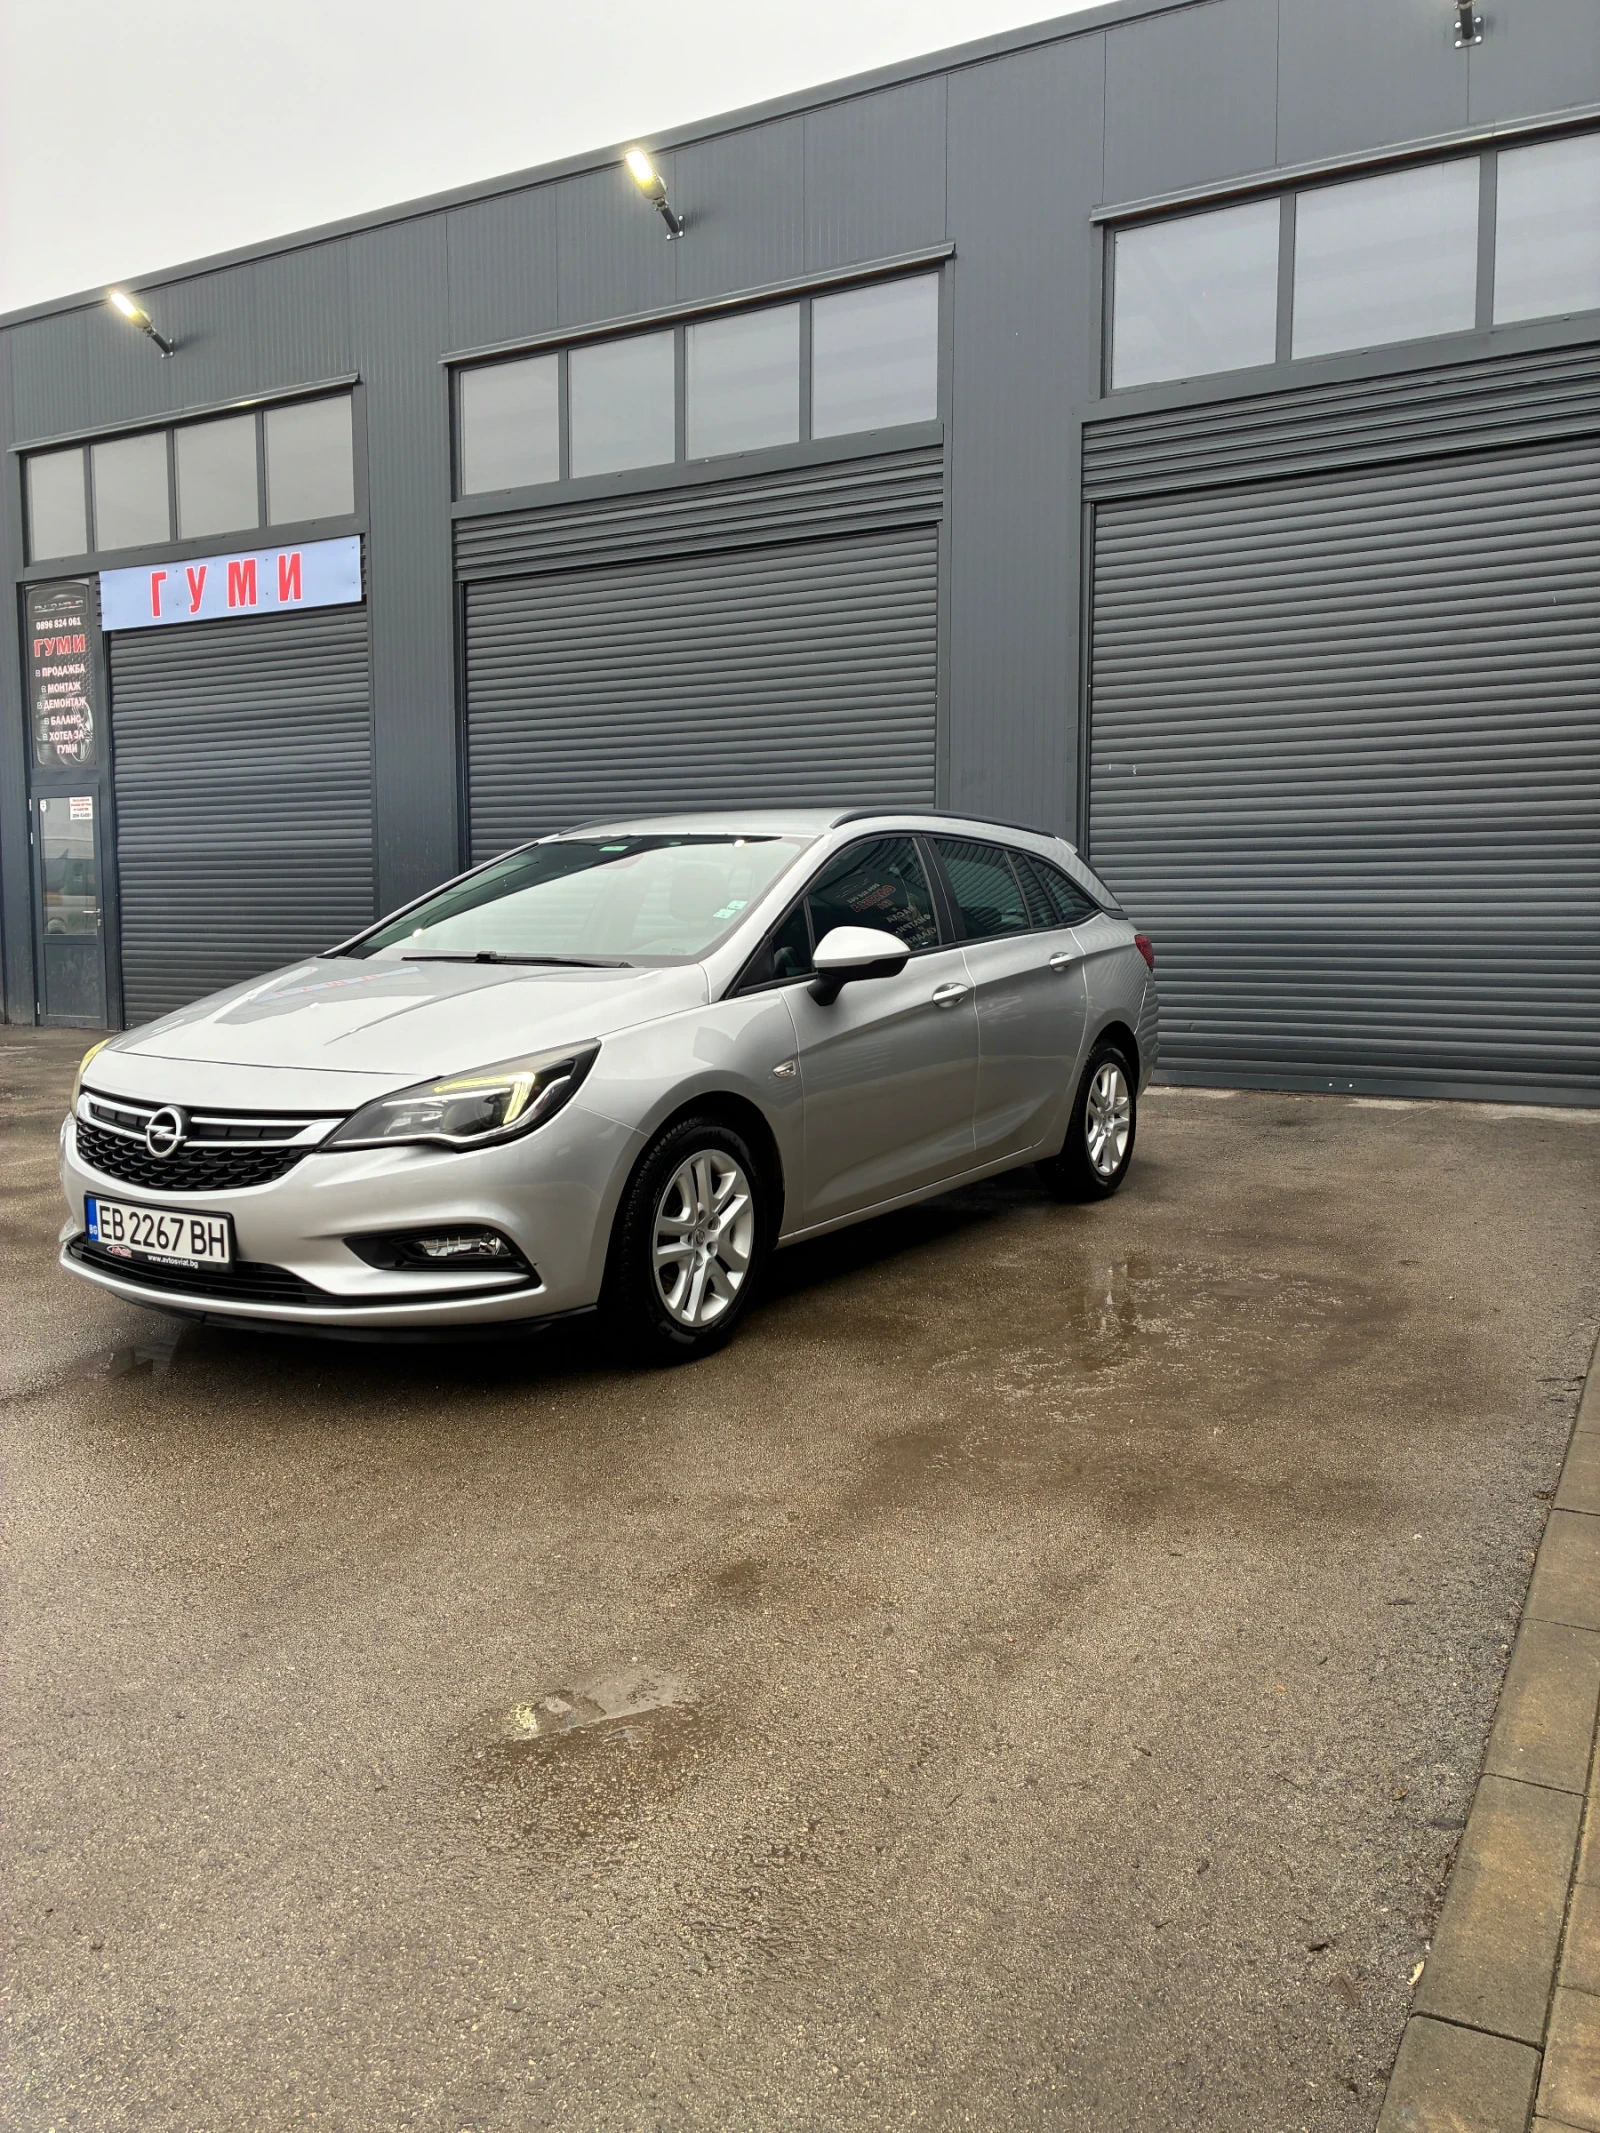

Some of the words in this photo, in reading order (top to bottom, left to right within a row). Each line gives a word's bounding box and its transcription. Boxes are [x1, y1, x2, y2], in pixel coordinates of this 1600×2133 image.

[151, 552, 302, 617] ГУМИ
[36, 620, 53, 630] 0896
[54, 618, 67, 628] 824
[68, 616, 81, 626] 061
[34, 634, 86, 657] ГУМИ
[42, 663, 86, 677] ПРОДАЖБА
[47, 681, 81, 694] МОНТАЖ
[43, 697, 86, 710] ДЕМОНТАЖ
[50, 714, 82, 725] БАЛАНС
[49, 731, 72, 741] ХОТЕЛ
[57, 744, 78, 754] ГУМИ
[89, 1224, 98, 1235] BG
[99, 1204, 125, 1241] EB
[129, 1211, 184, 1252] 2267
[190, 1219, 225, 1258] BH
[147, 1254, 199, 1269] www.avtosviat.bg
